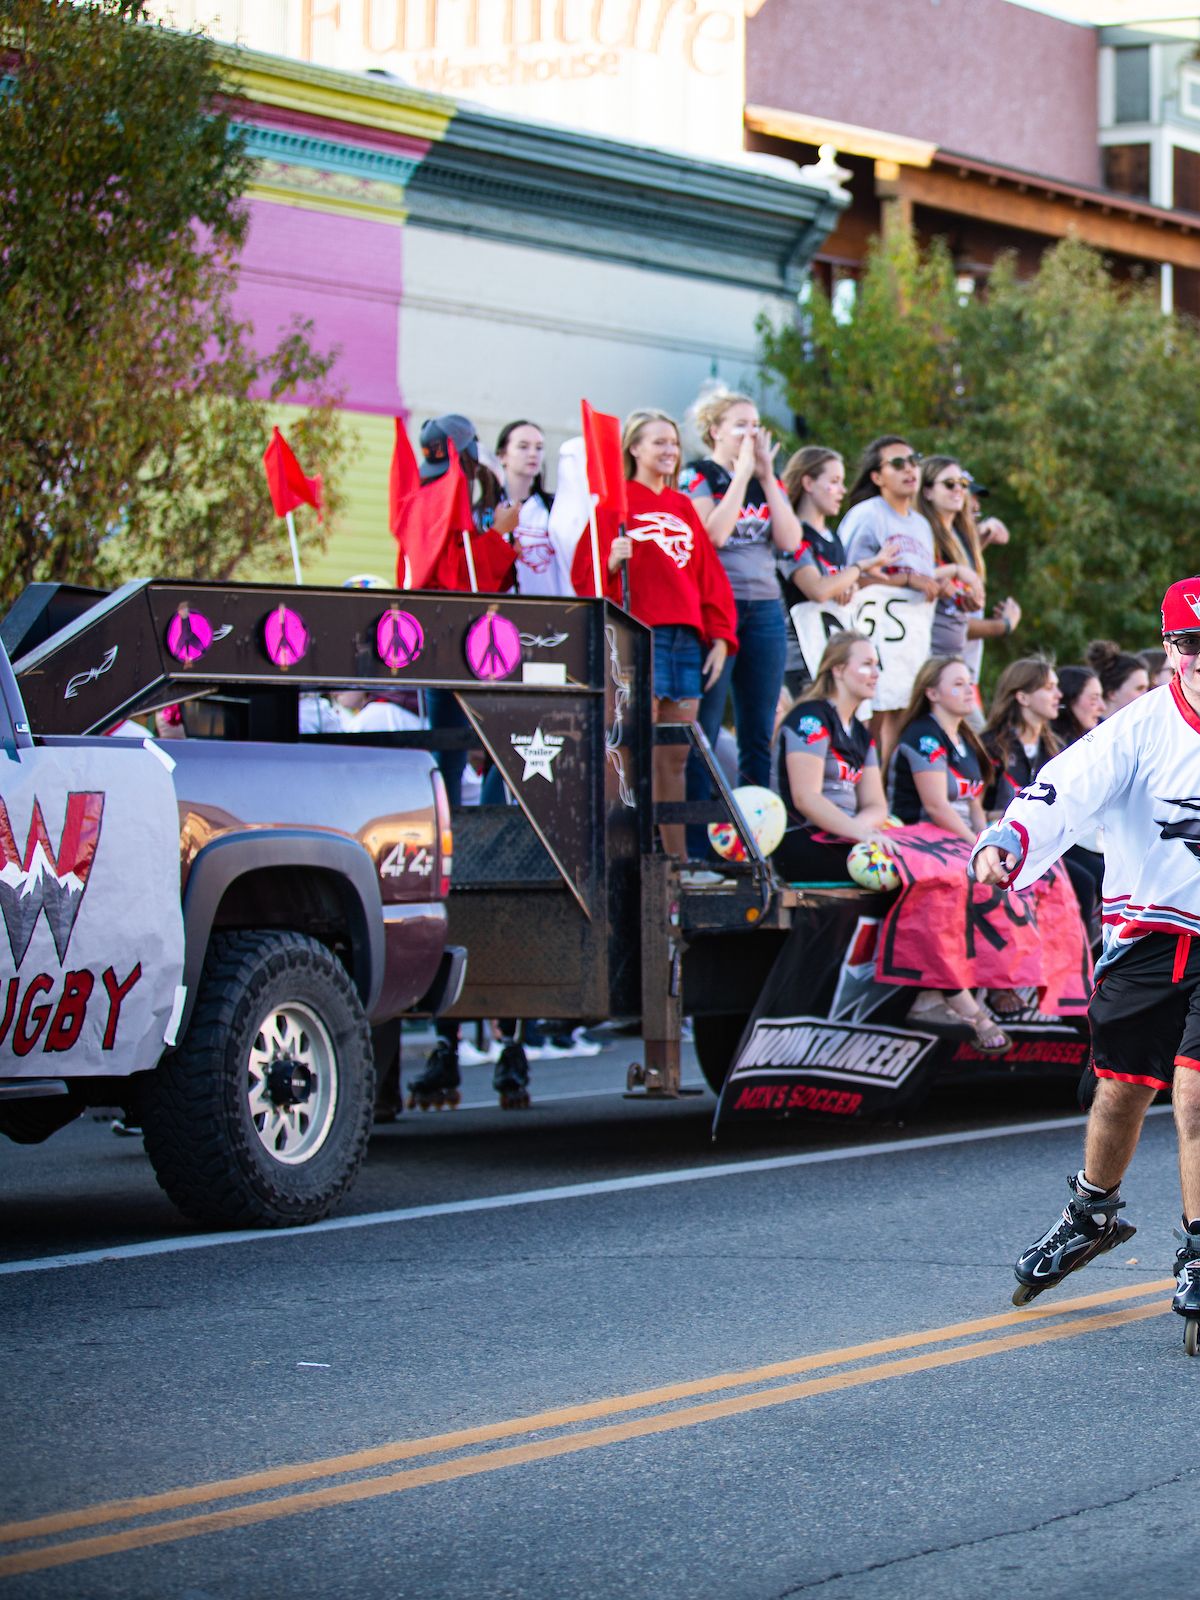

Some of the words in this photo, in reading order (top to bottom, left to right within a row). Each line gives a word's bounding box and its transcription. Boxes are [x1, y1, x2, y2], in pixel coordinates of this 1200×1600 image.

[412, 50, 622, 90] Warehouse
[524, 748, 553, 756] Trailer
[739, 1026, 922, 1078] MOUNTAINEER
[734, 1086, 787, 1110] MEN'S
[785, 1085, 863, 1115] SOCCER
